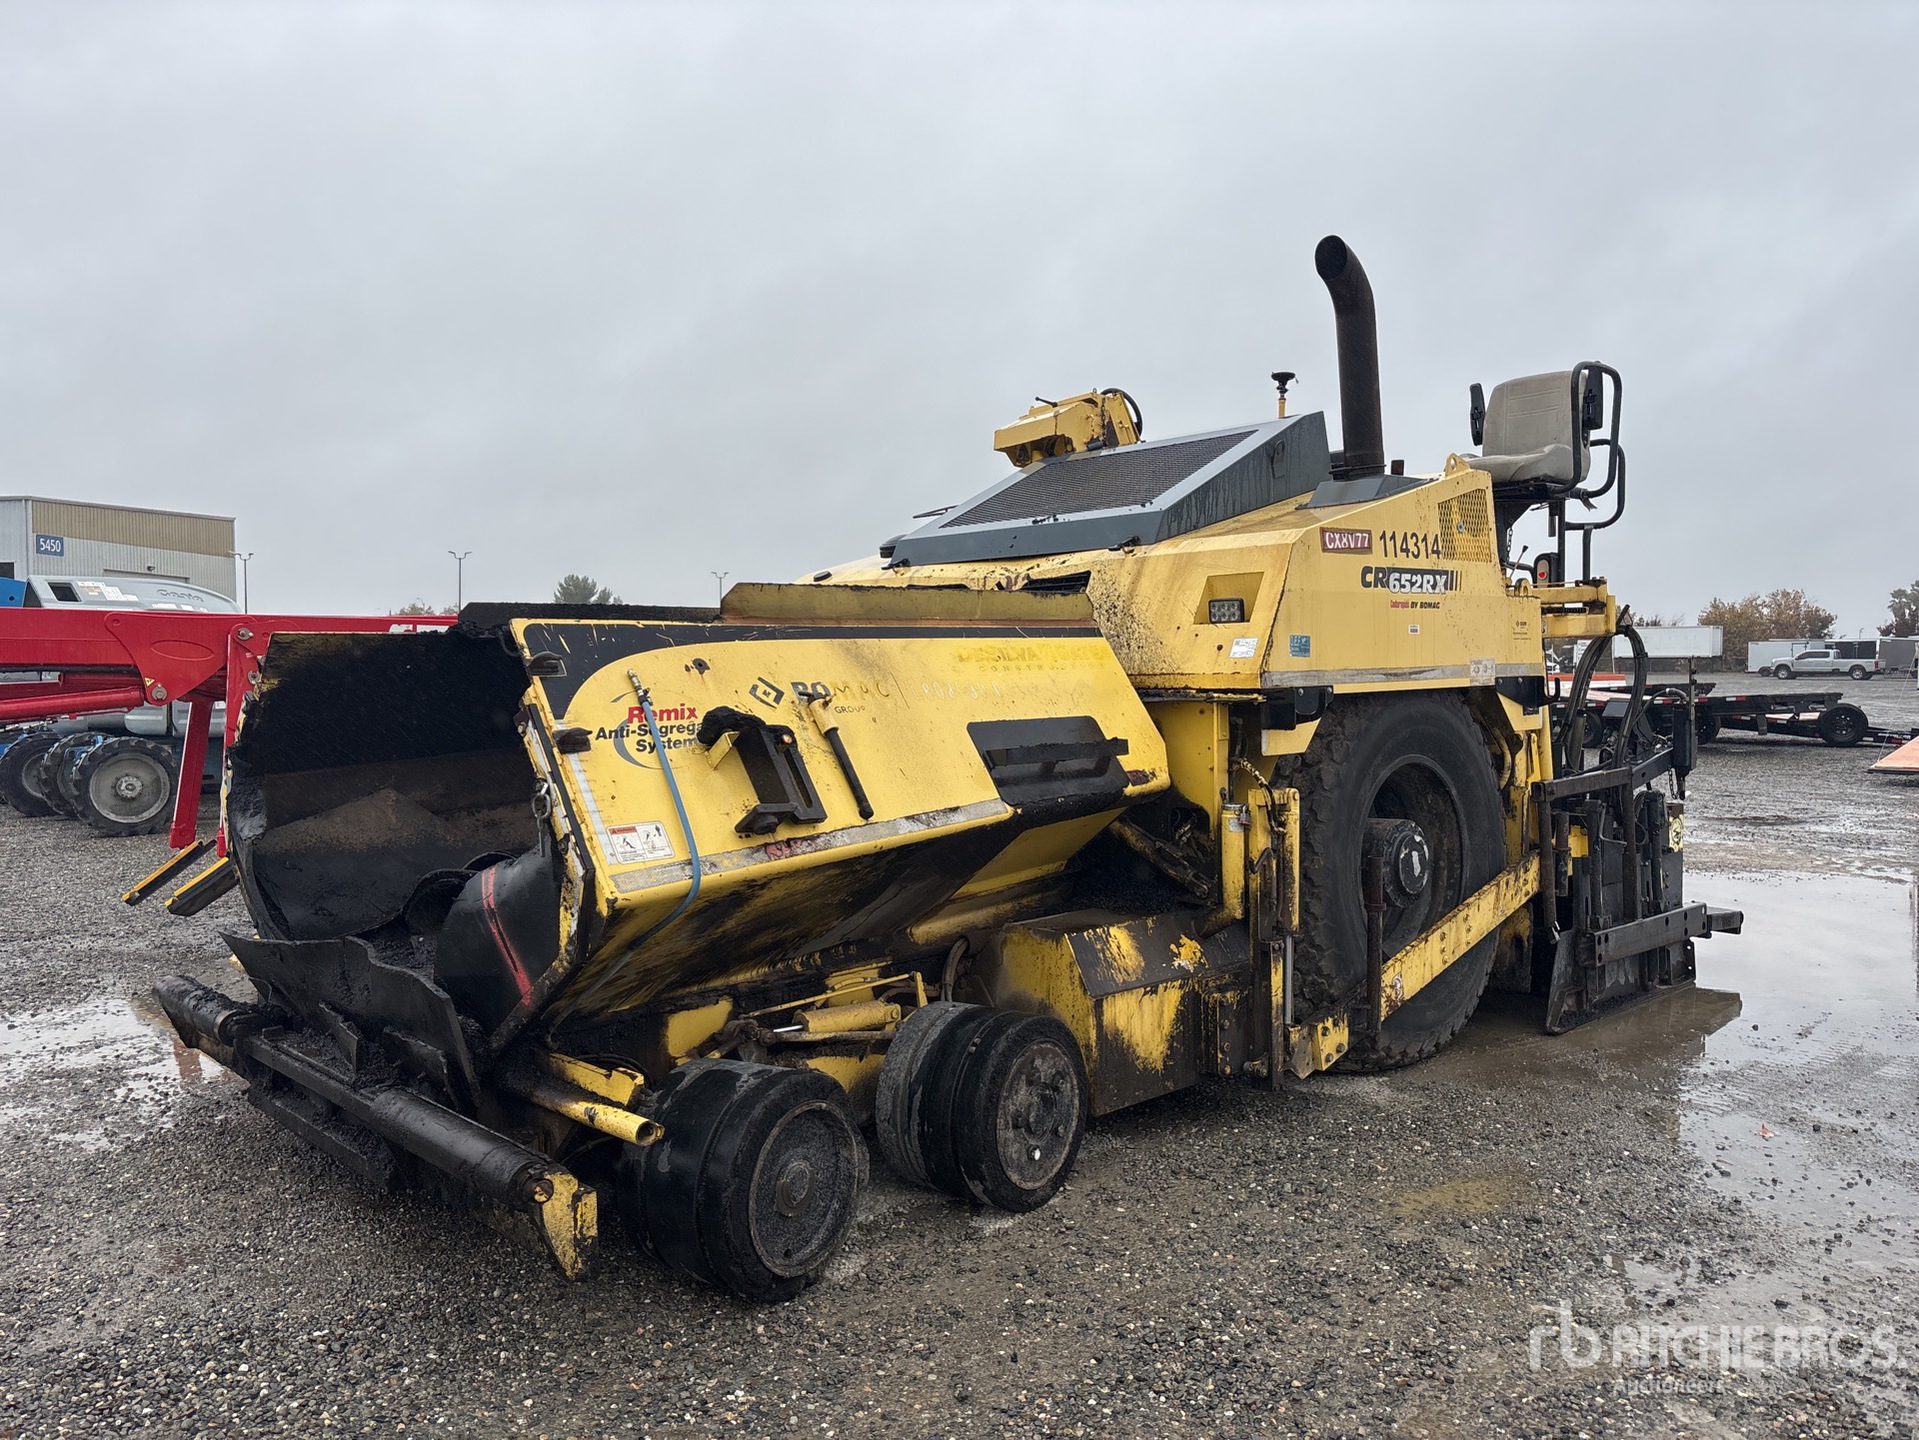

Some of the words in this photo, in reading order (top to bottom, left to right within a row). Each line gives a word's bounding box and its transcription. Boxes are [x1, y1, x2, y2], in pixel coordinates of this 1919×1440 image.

[40, 538, 61, 553] 5450
[1325, 532, 1369, 549] CX8V77
[1380, 530, 1442, 559] 114314
[1410, 601, 1418, 609] BY
